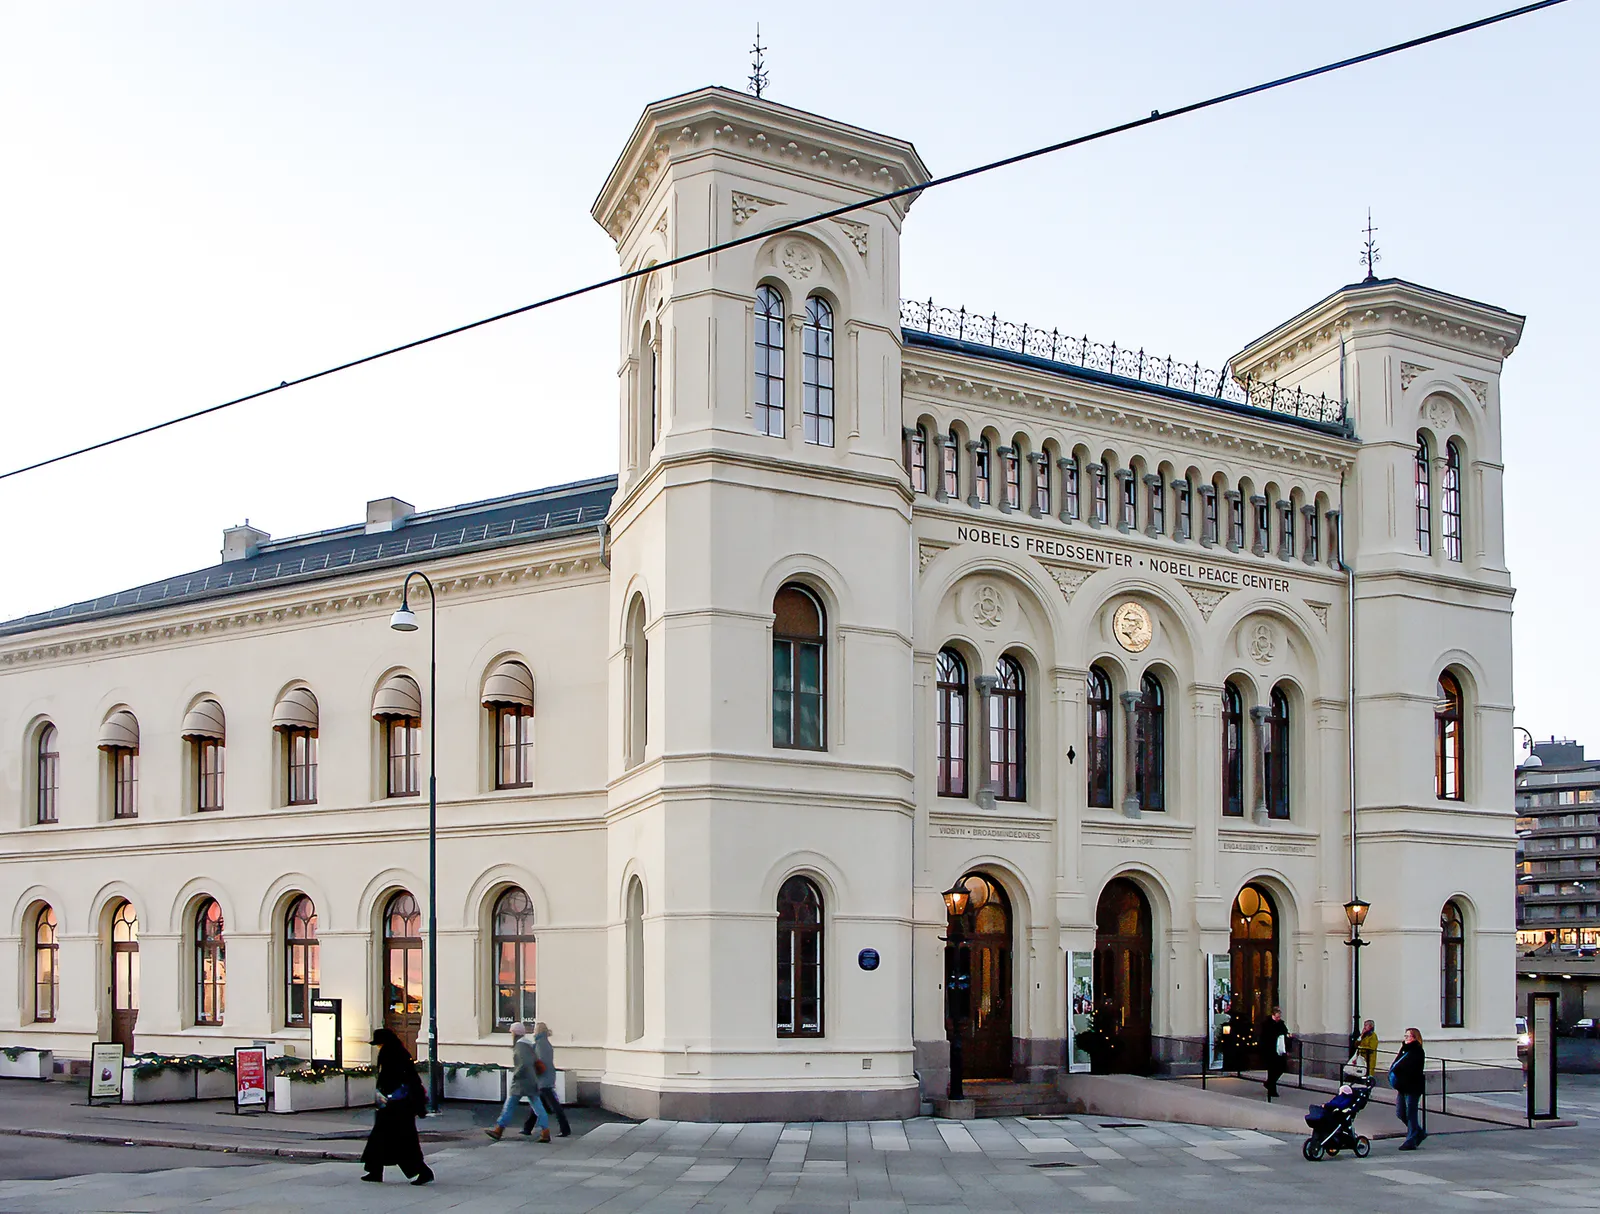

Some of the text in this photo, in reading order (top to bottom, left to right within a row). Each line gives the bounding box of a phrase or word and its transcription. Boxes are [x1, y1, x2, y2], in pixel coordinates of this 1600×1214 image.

[957, 527, 1290, 593] NOBELS FREDSSENTER NOBEL PEACE CENTER
